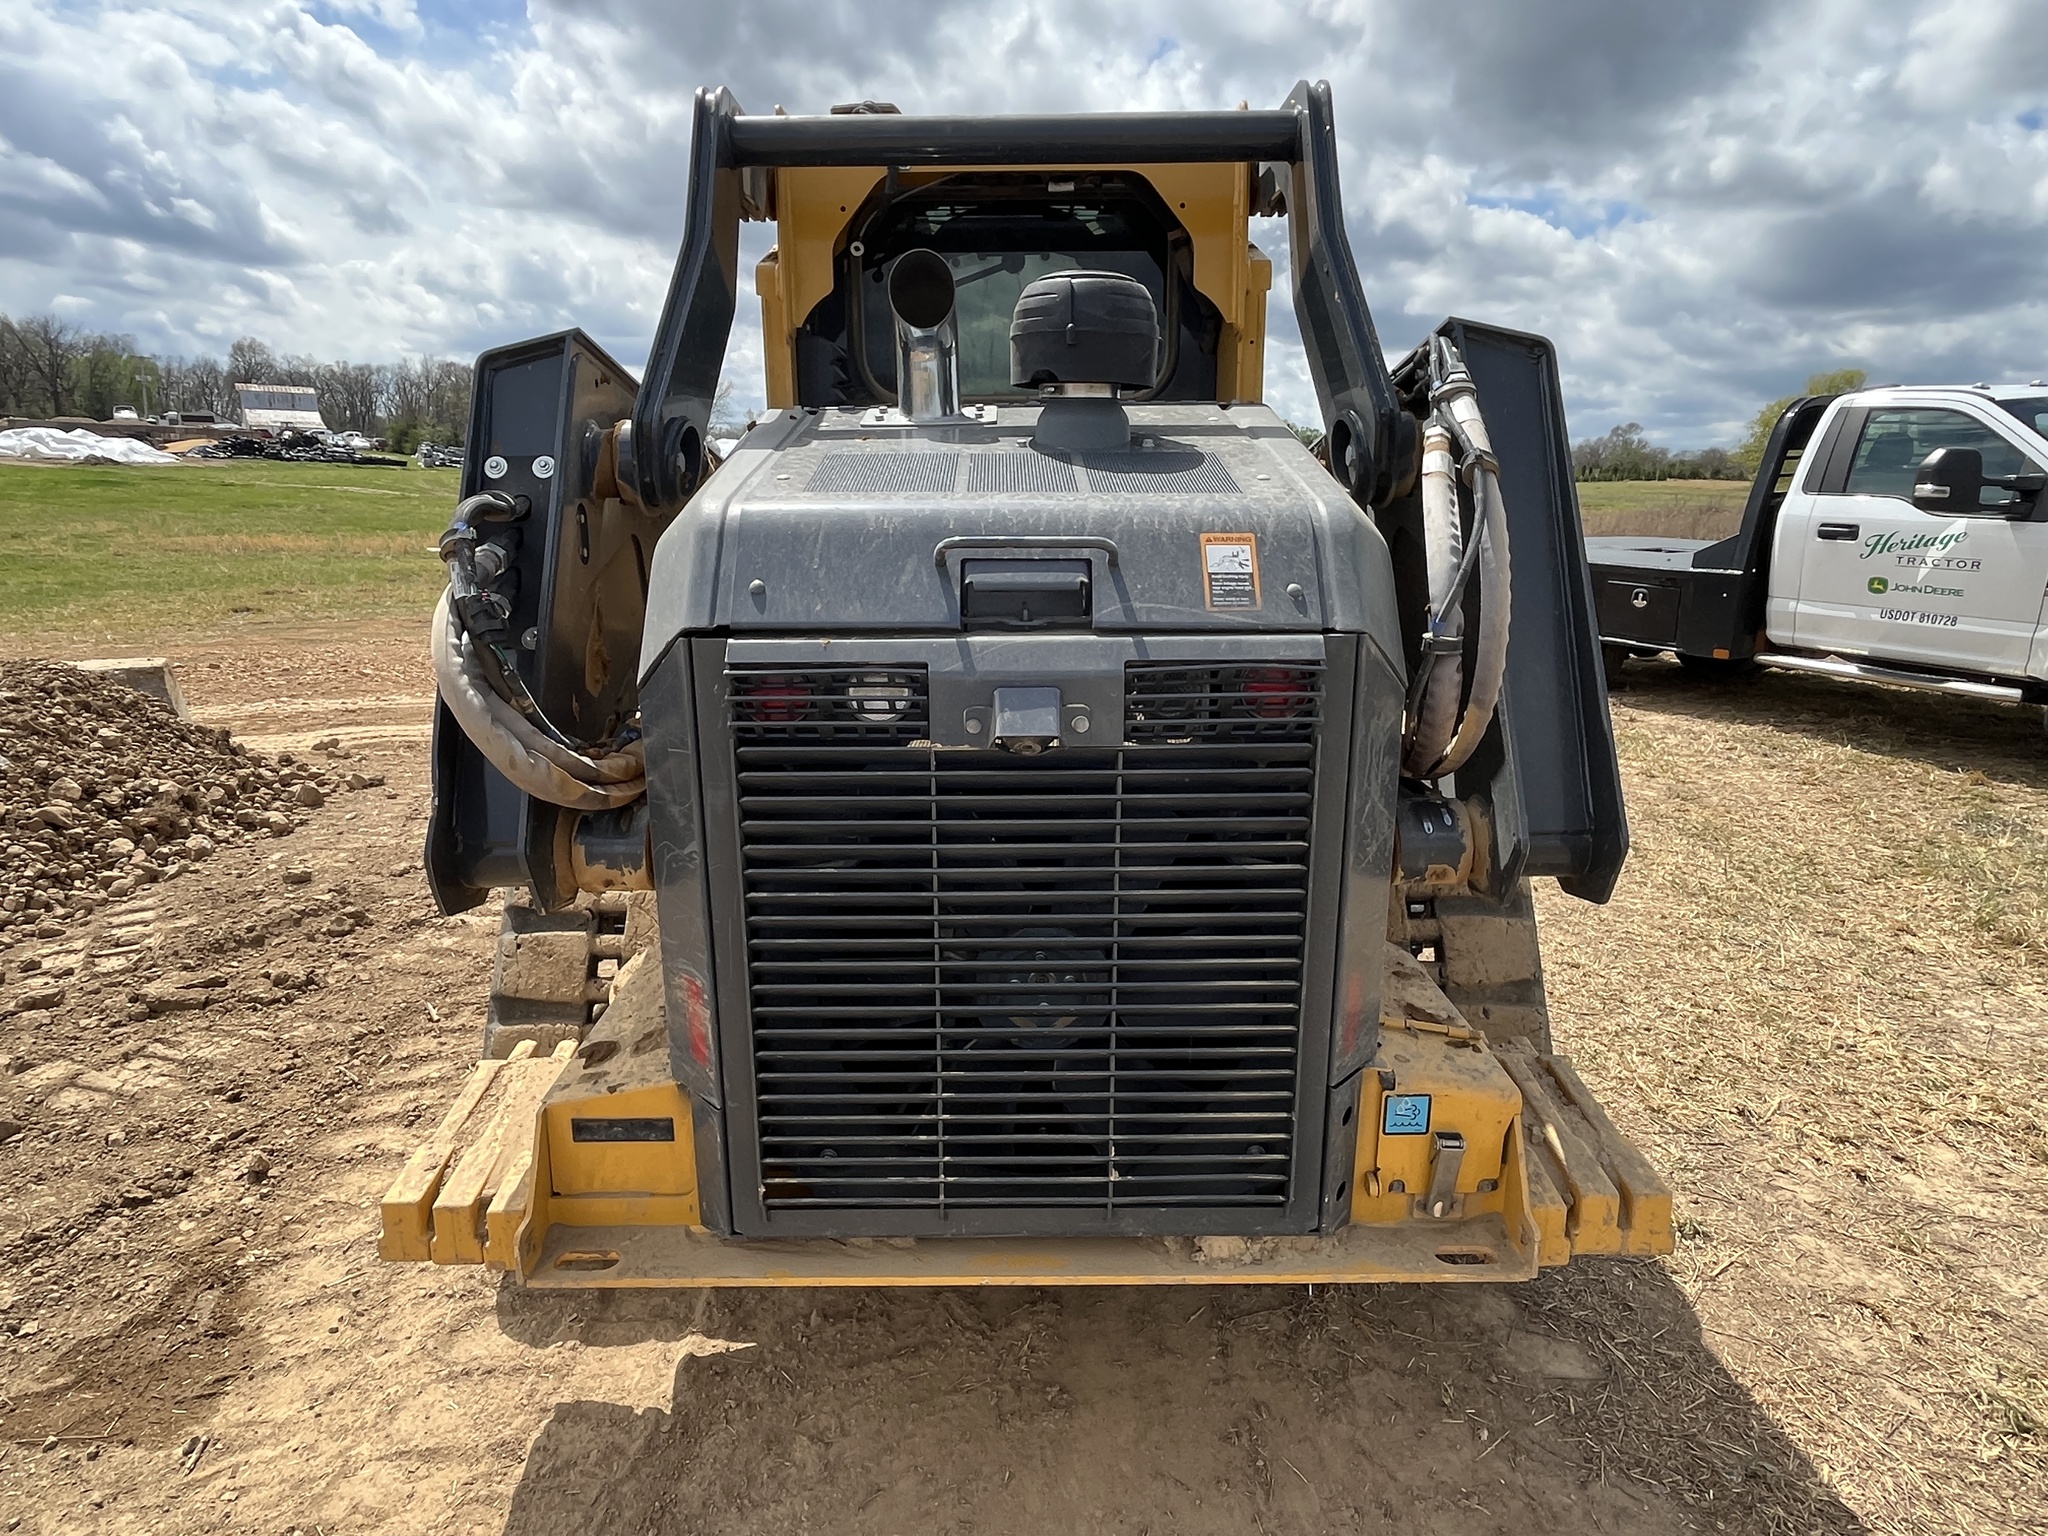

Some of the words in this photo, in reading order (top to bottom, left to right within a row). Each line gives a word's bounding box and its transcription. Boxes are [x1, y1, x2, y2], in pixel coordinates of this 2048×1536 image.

[1860, 531, 1968, 559] Heritage
[1896, 556, 1981, 570] TRACTOR
[1890, 583, 1922, 594] JOHN
[1923, 585, 1964, 597] DEERE
[1880, 608, 1917, 622] USDOT
[1919, 612, 1958, 627] 810728
